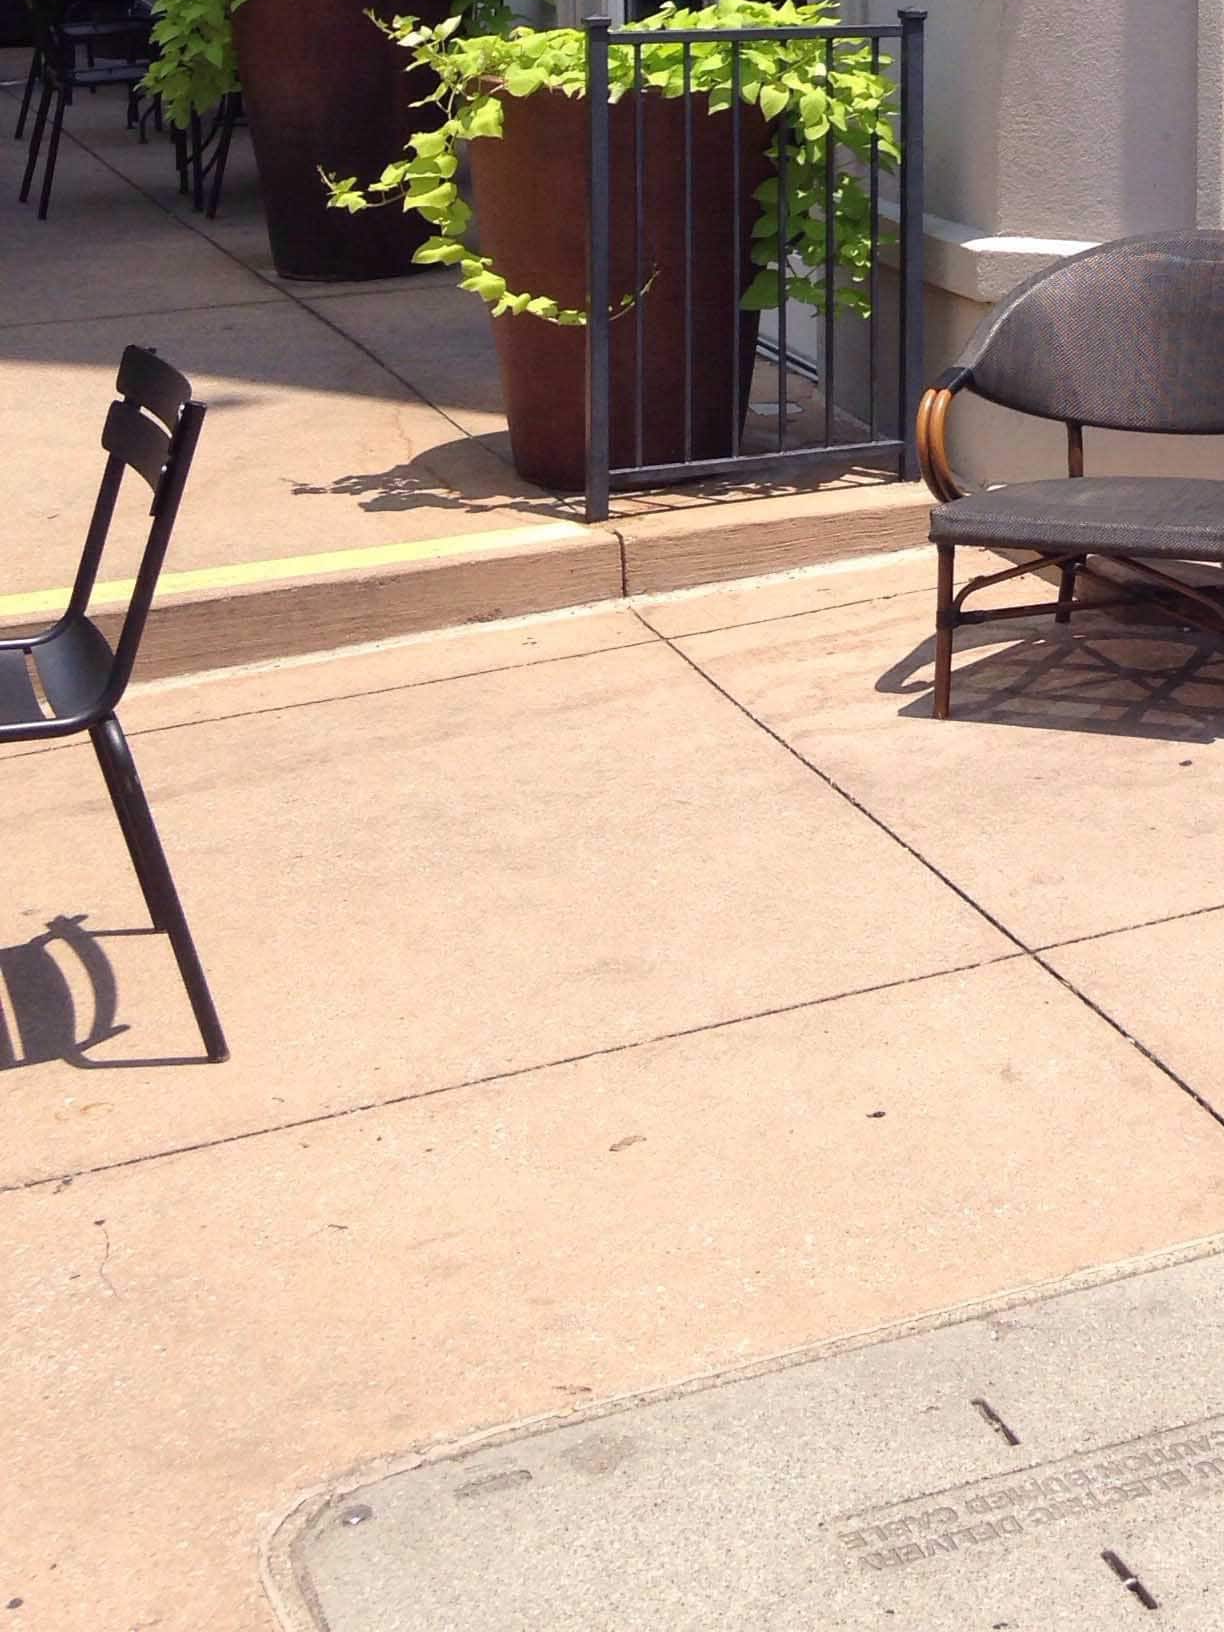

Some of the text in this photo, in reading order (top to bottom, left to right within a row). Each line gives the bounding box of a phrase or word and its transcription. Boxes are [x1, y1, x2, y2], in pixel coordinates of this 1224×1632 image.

[964, 1468, 1091, 1515] BURIED
[1027, 1469, 1191, 1524] ELECTRIC
[838, 1505, 960, 1552] CABLE
[857, 1515, 1024, 1571] DELIVERY
